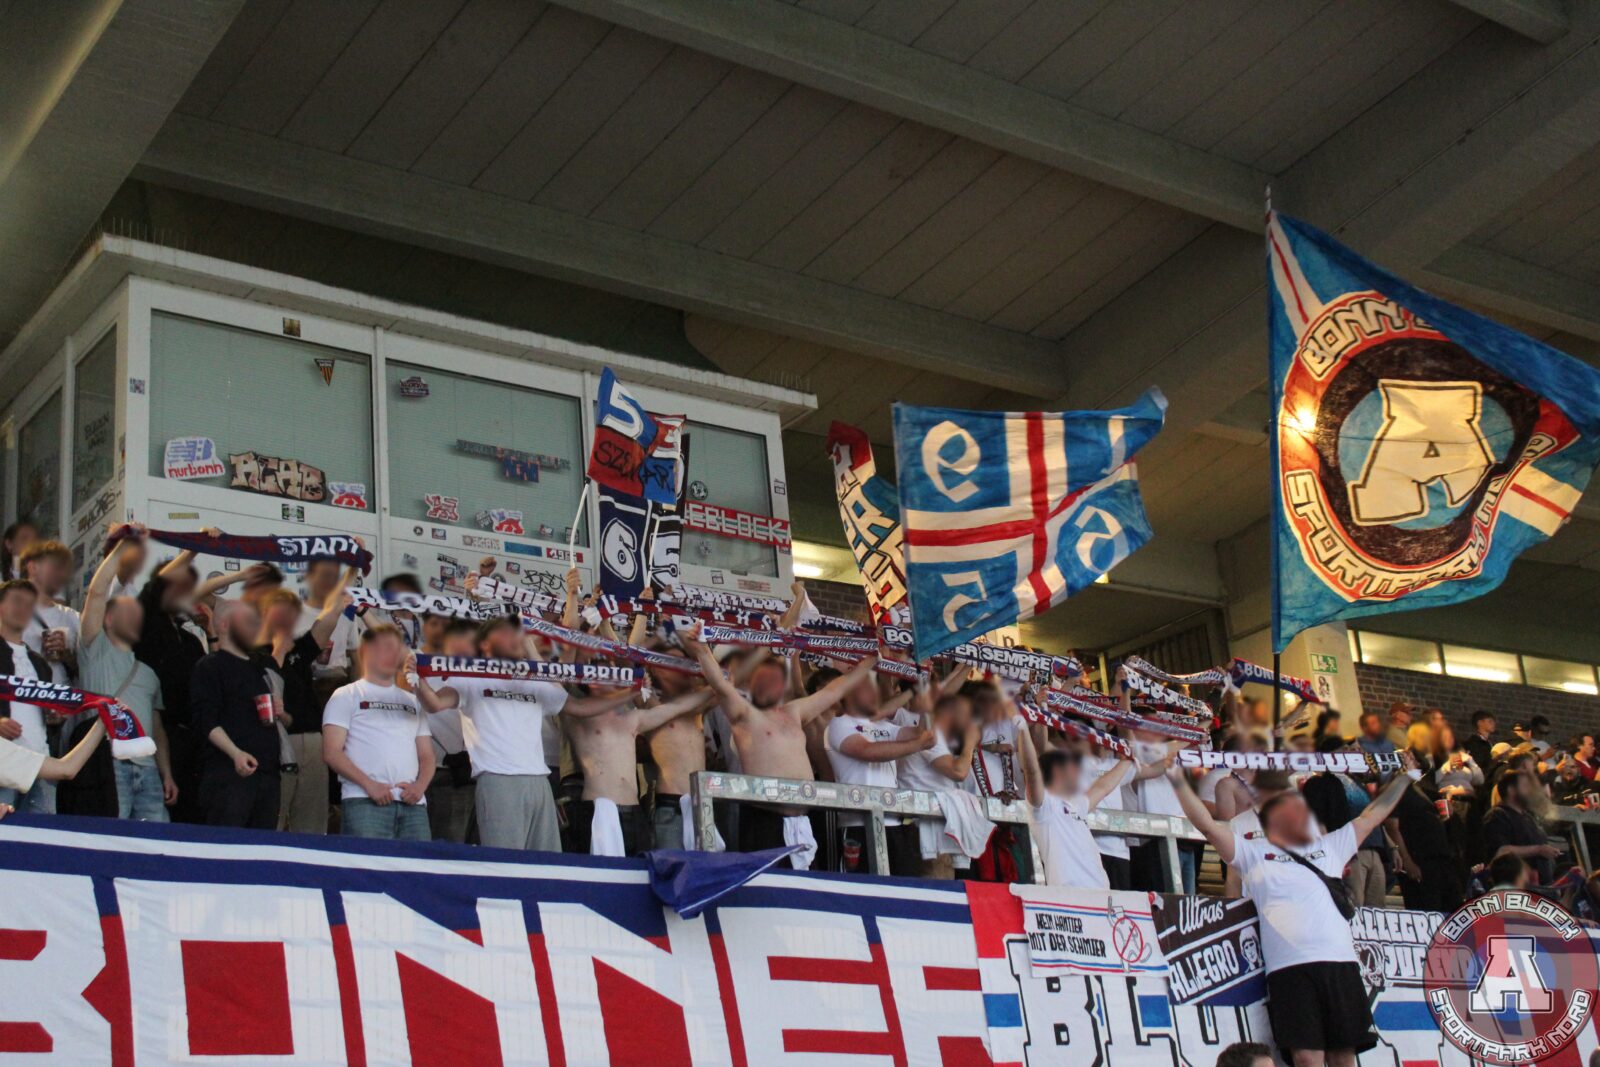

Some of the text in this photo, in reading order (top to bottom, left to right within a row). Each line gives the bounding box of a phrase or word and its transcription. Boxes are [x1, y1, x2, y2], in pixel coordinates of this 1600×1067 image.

[537, 662, 577, 678] CON
[15, 687, 83, 703] 01/04 E.V.
[1180, 750, 1368, 773] SPORTCLUB
[1180, 897, 1225, 936] Ultras
[1028, 932, 1047, 951] MIT
[1048, 932, 1067, 952] DER
[1169, 942, 1240, 1001] ALLEGRO
